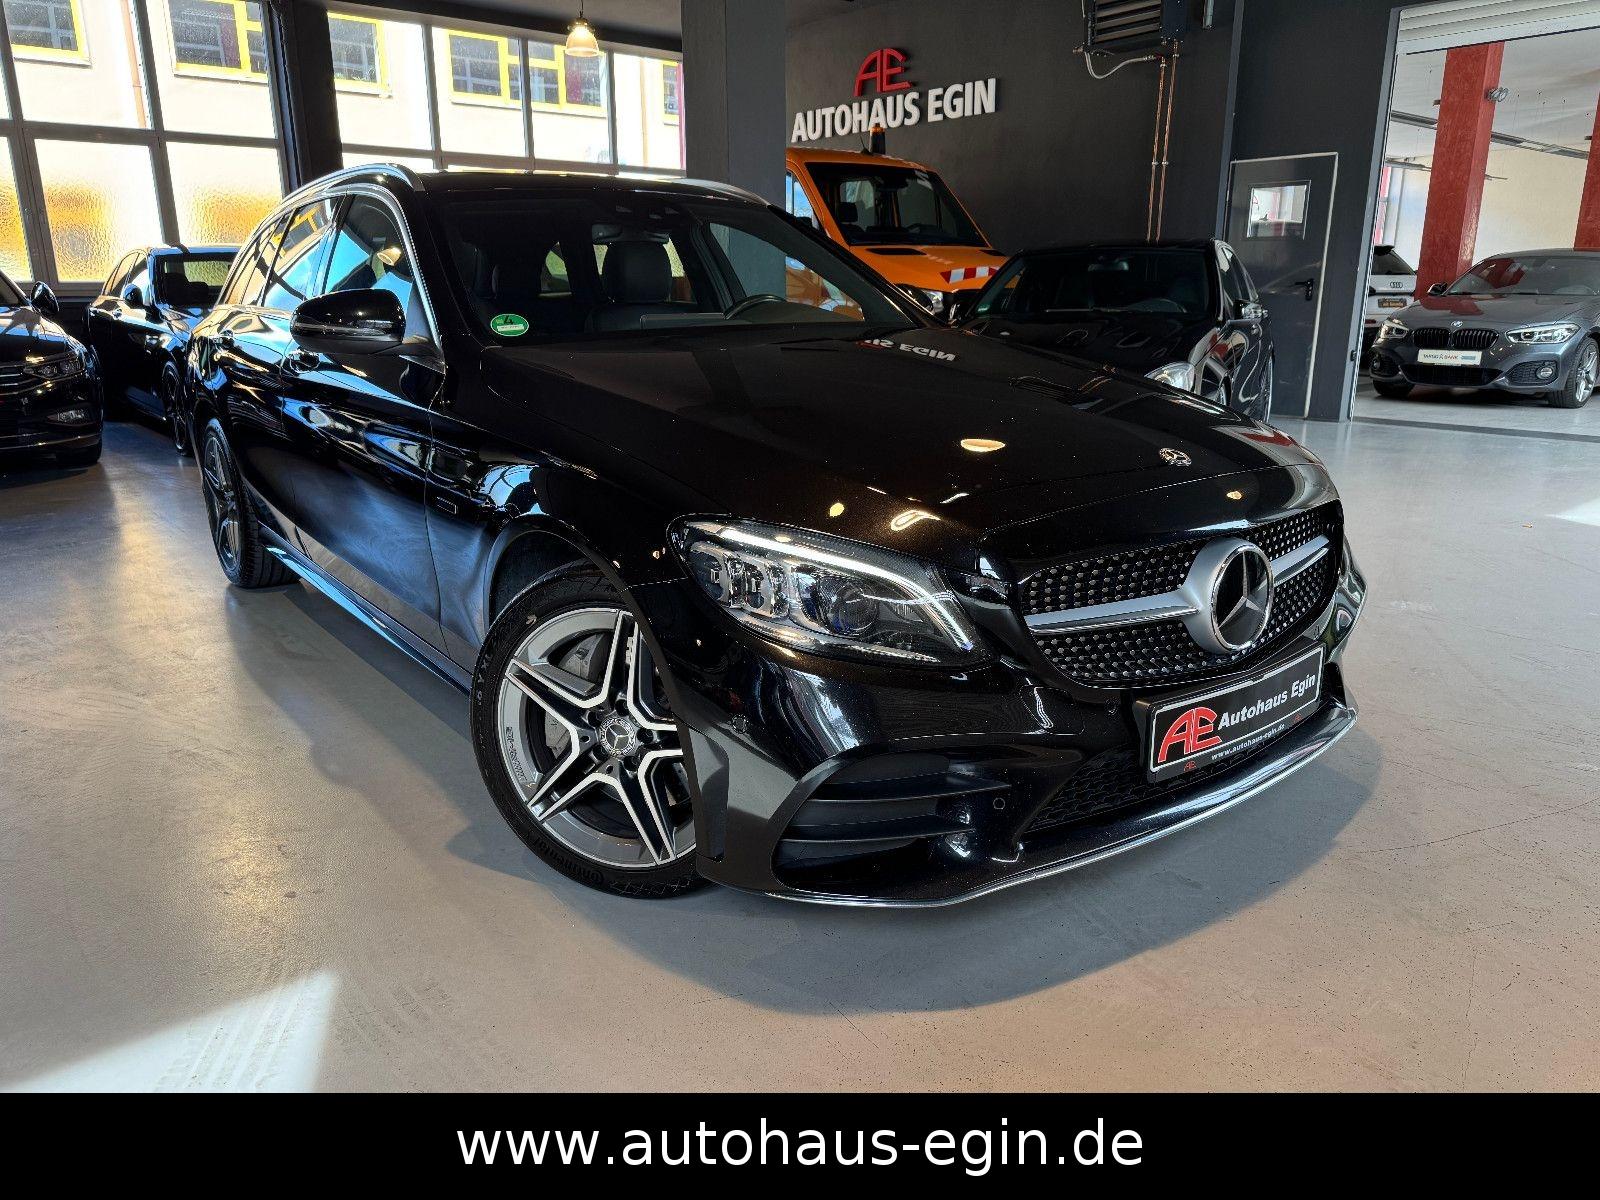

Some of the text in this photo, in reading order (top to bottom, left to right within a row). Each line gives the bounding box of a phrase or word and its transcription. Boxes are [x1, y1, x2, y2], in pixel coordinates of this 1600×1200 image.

[853, 48, 912, 97] AE
[791, 78, 996, 143] AUTOHAUS EGIN
[1218, 673, 1316, 730] Autohaus Egin
[1158, 706, 1222, 763] AE
[1211, 723, 1285, 761] www.autohaus-egin.de
